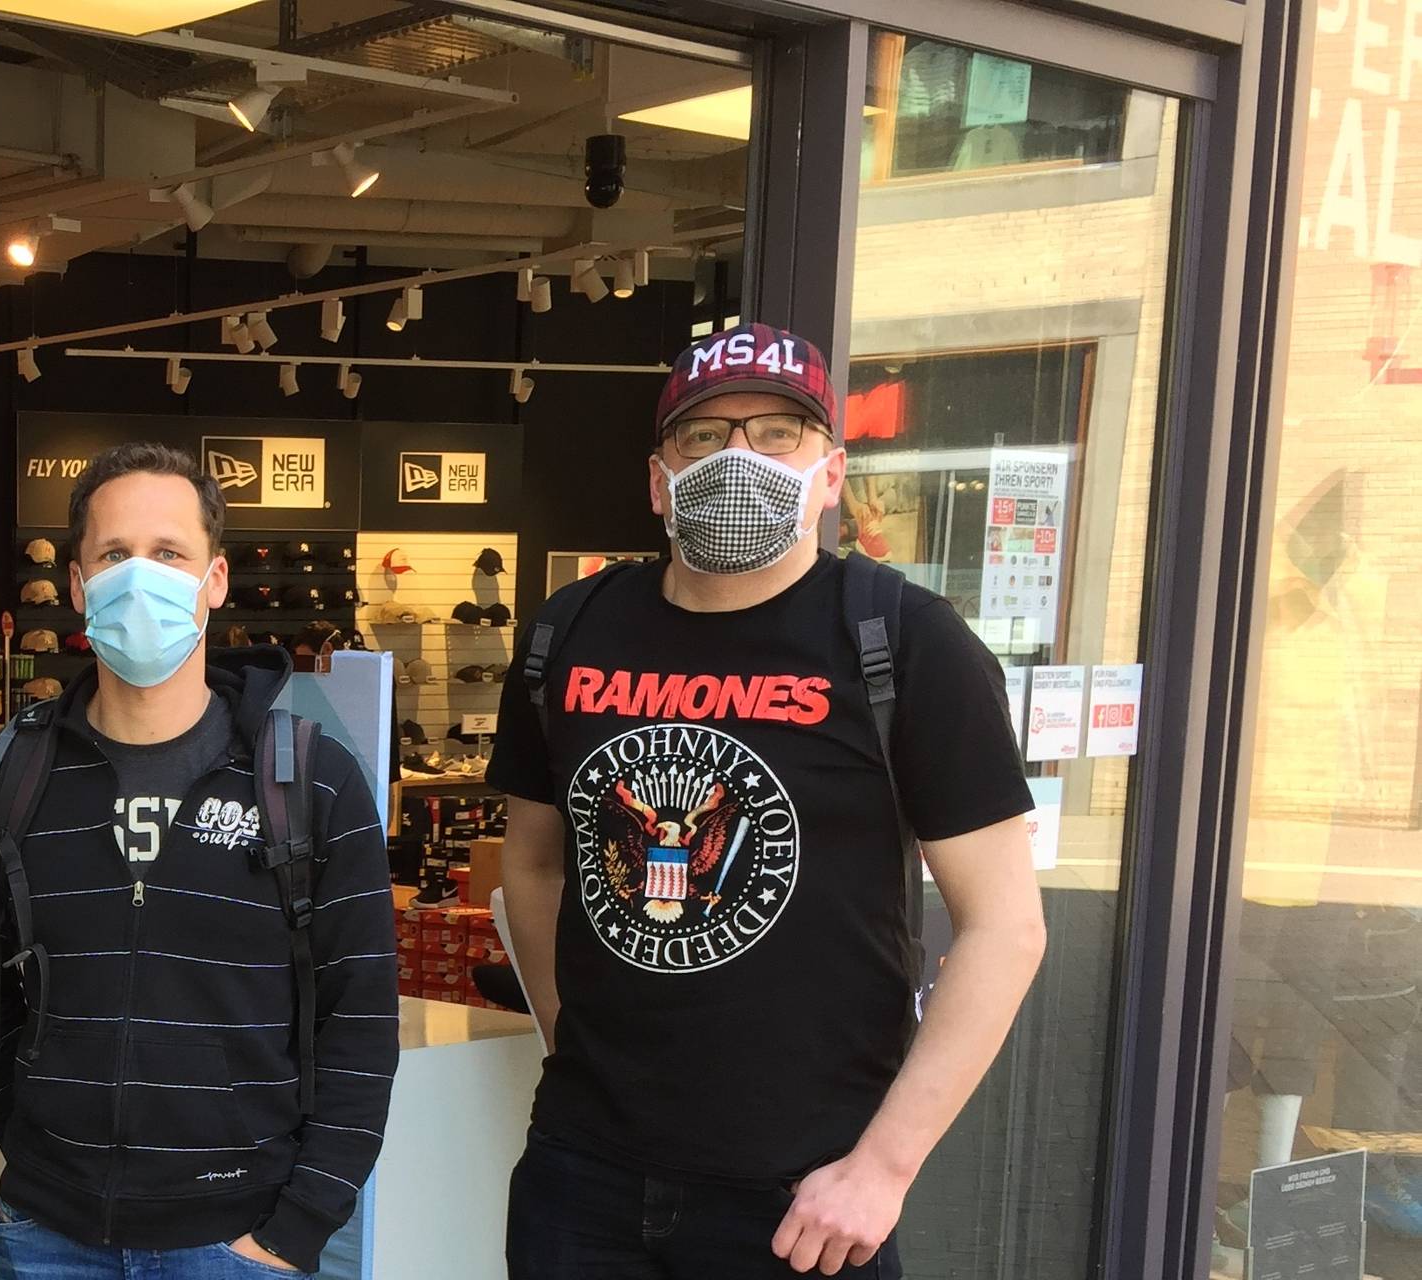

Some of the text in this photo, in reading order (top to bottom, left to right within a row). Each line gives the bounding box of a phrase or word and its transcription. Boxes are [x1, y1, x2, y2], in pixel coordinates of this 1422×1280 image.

[688, 333, 803, 381] MS4L
[27, 458, 56, 478] FLY
[273, 453, 315, 472] NEW
[448, 464, 479, 478] NEW
[996, 460, 1058, 475] WIR SPONSERN
[273, 474, 314, 492] ERA
[448, 479, 478, 491] ERA
[994, 474, 1022, 488] IHREN
[565, 666, 832, 725] RAMONES
[571, 728, 795, 967] JOHNNY JOEY DEEDEE TOMMY
